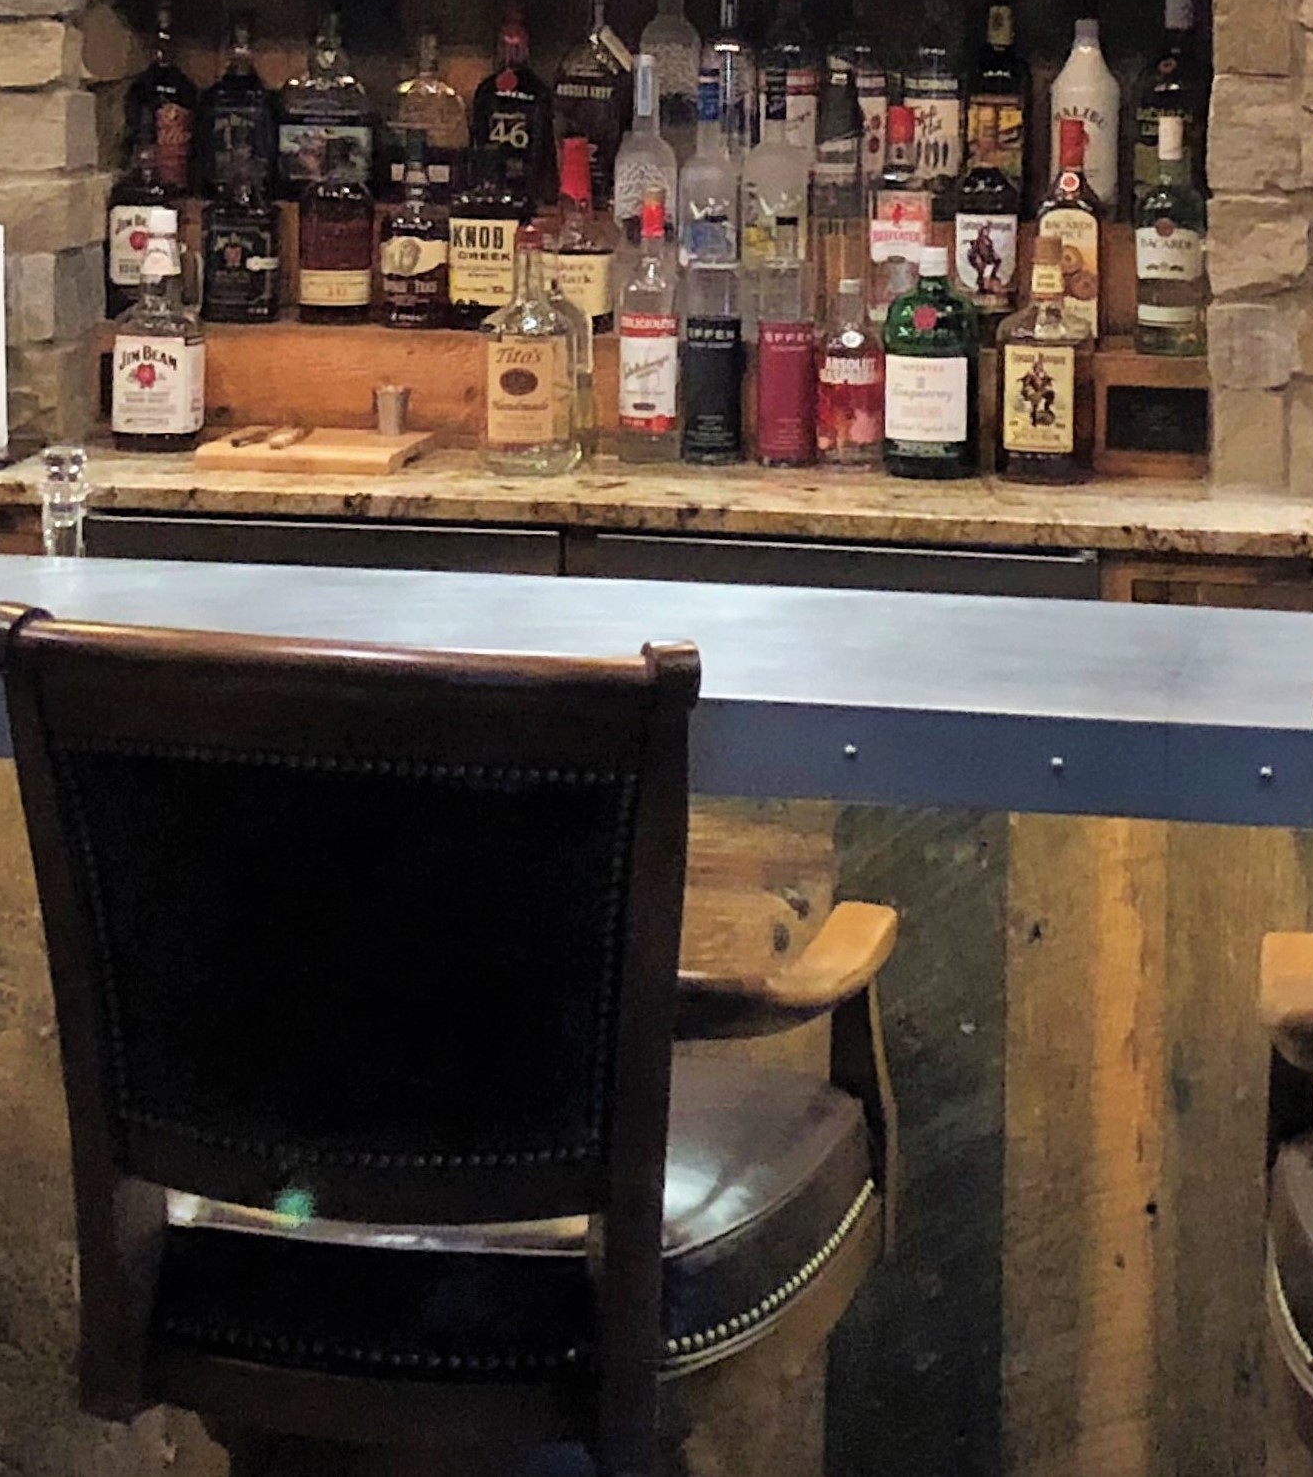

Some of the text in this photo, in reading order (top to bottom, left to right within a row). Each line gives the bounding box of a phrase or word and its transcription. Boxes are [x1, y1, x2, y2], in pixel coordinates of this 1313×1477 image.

[489, 120, 530, 149] 46
[1043, 221, 1094, 231] BACARDI
[452, 224, 505, 250] KNOB
[1140, 237, 1193, 249] BACARDI
[457, 251, 512, 262] CREEK
[119, 345, 178, 371] JIM BEAM
[495, 346, 544, 365] Tito's
